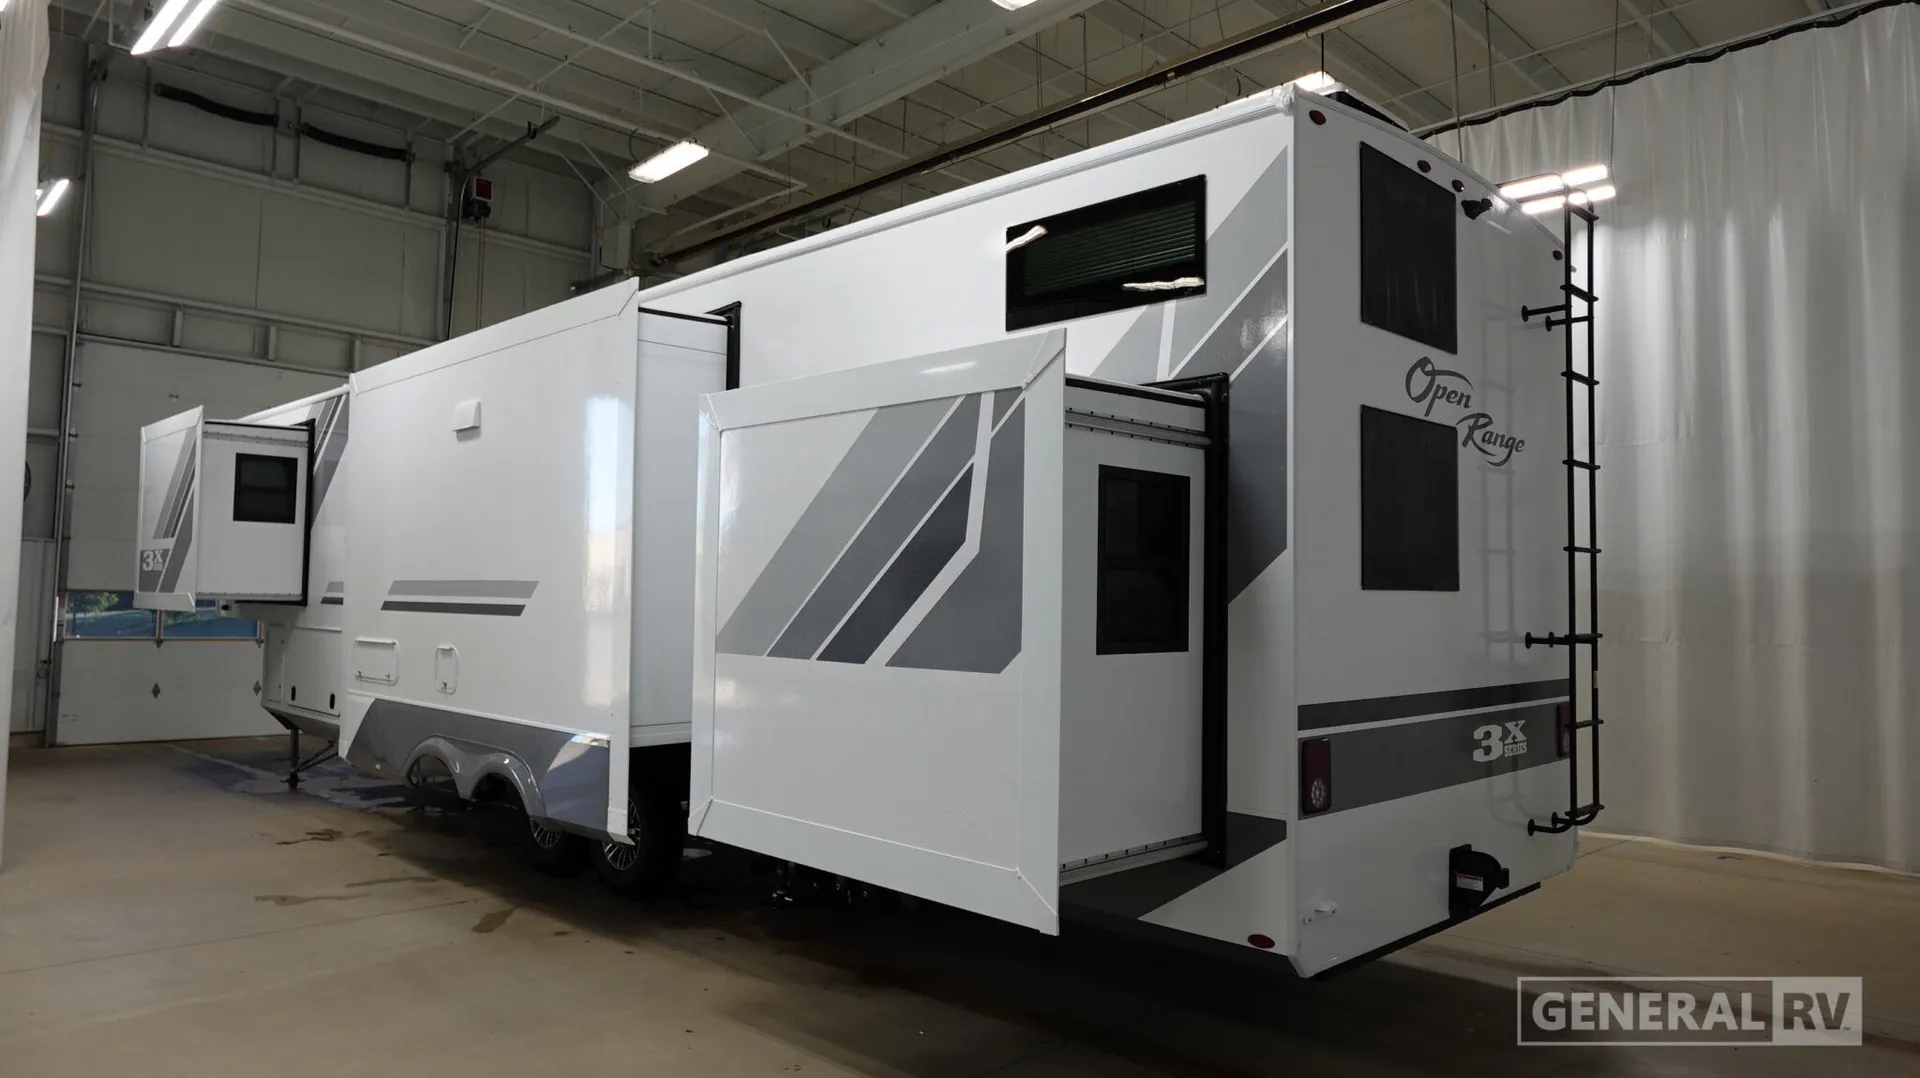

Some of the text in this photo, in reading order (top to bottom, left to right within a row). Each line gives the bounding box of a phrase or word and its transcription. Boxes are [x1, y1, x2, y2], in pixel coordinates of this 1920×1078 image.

[1405, 356, 1474, 417] Open
[1454, 412, 1526, 467] Range
[142, 550, 163, 571] 3X
[1472, 719, 1528, 763] 3X
